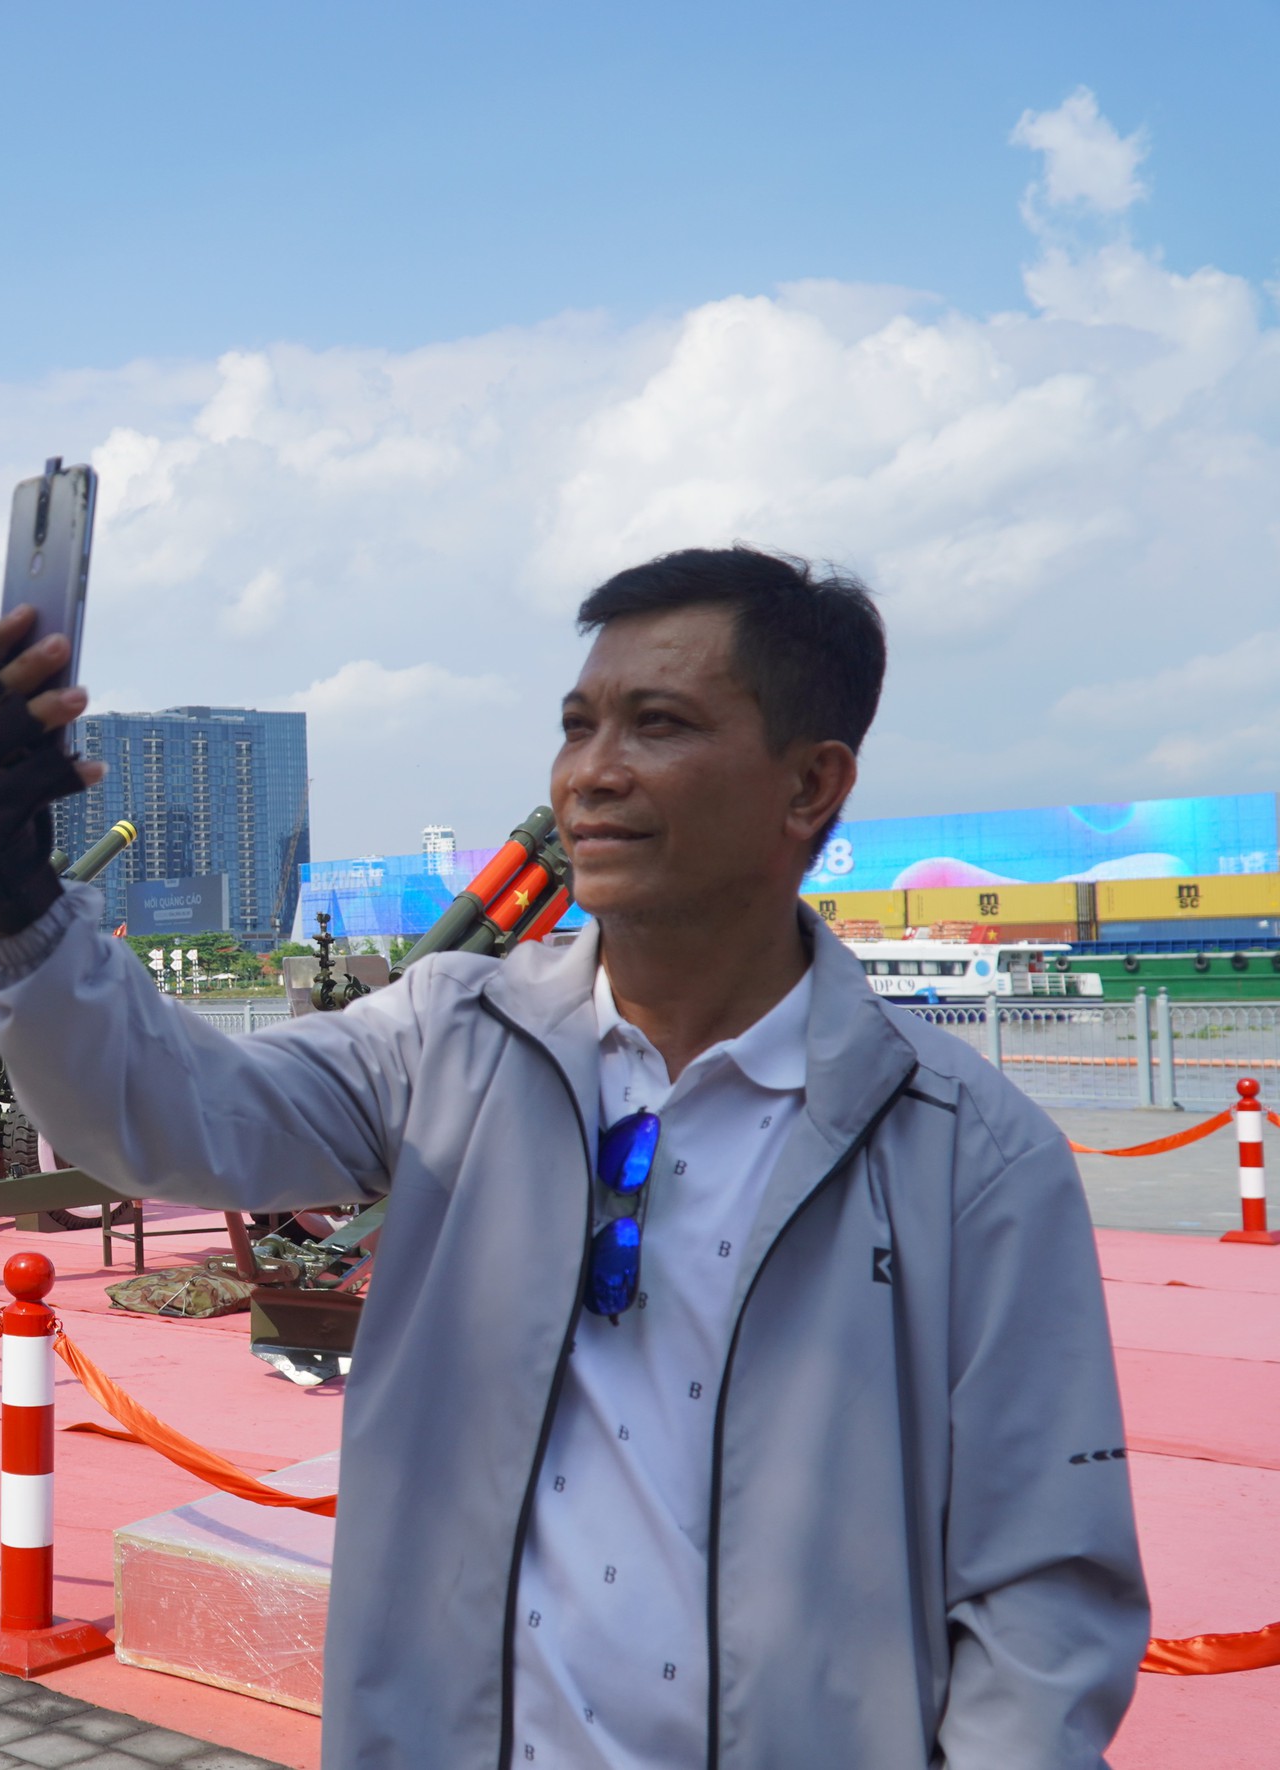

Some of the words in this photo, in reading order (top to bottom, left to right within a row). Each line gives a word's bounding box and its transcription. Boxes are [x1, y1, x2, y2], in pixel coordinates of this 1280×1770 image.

[186, 892, 202, 905] CÁO
[897, 978, 915, 992] C9
[674, 1159, 688, 1176] B
[718, 1240, 732, 1258] B
[638, 1291, 648, 1310] B
[689, 1381, 702, 1400] B
[619, 1425, 629, 1441] B
[553, 1475, 566, 1493] B
[604, 1565, 617, 1584] B
[528, 1610, 542, 1628] B
[663, 1662, 677, 1681] B
[524, 1744, 535, 1762] B
